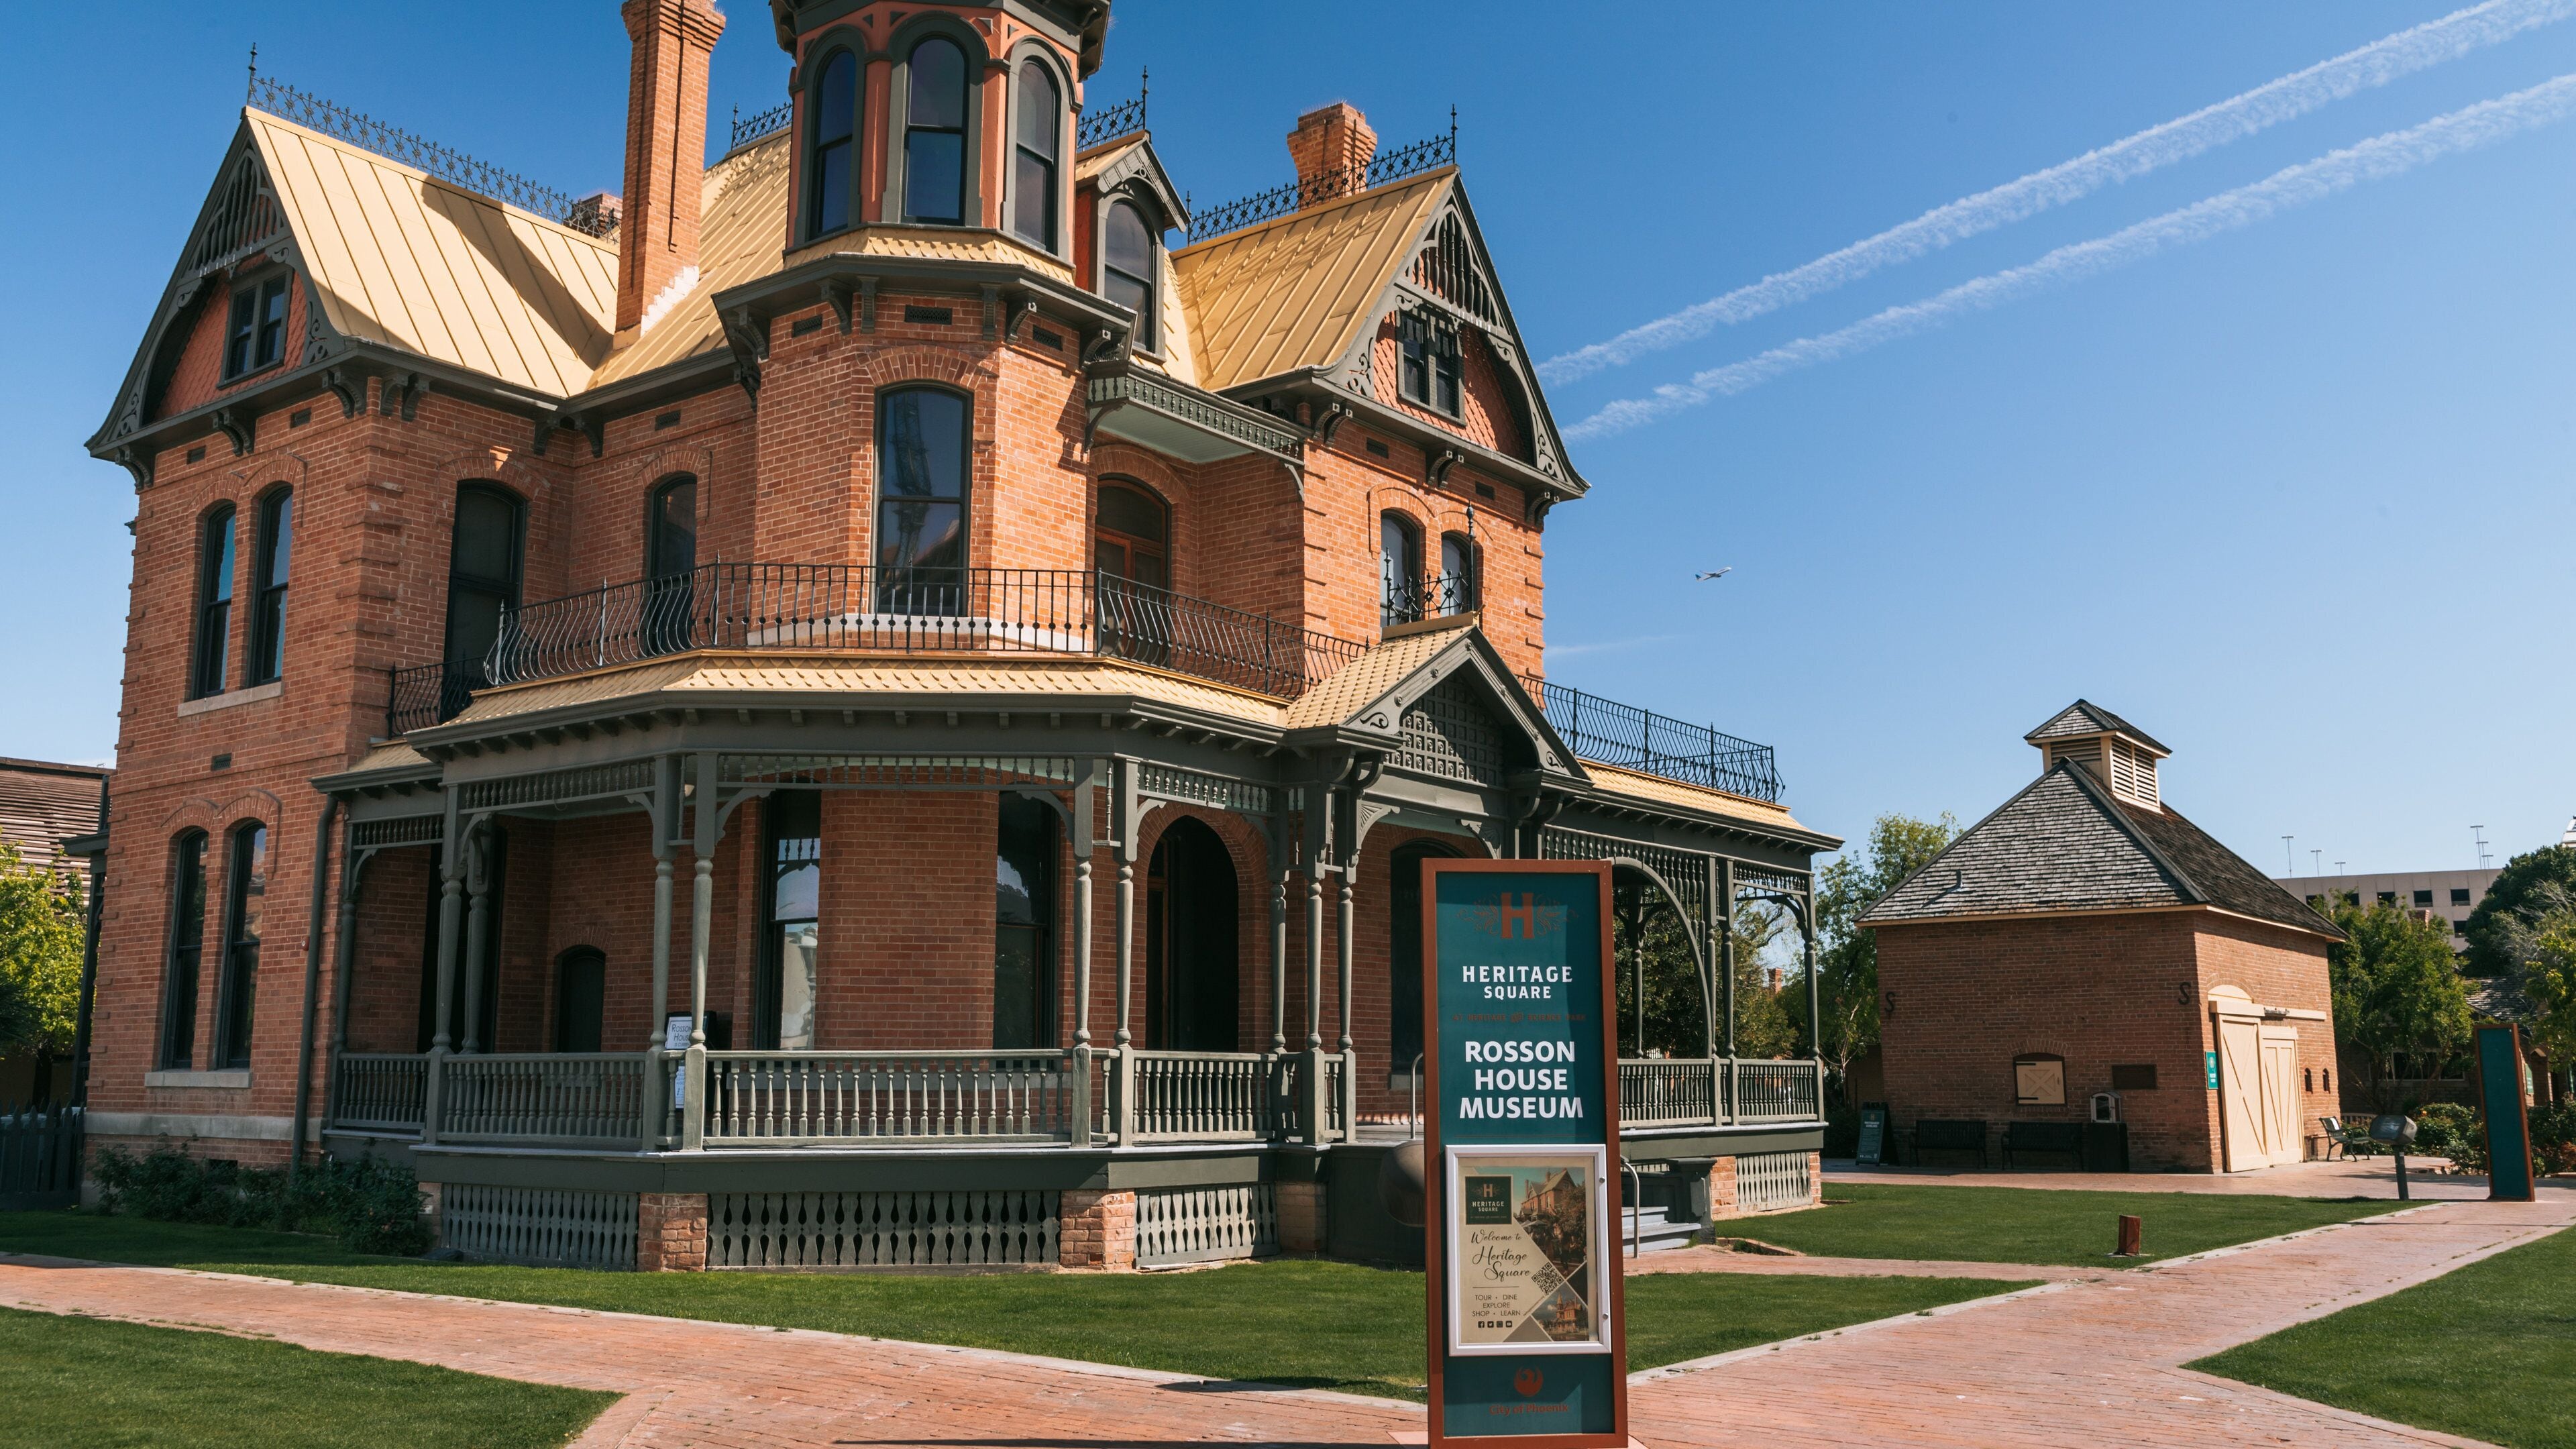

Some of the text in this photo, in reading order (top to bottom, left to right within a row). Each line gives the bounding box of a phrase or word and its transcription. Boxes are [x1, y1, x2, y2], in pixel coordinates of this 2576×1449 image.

[1500, 892, 1534, 939] H
[1462, 965, 1573, 983] HERITAGE
[1483, 985, 1552, 1000] SQUARE
[674, 1032, 688, 1041] HOUS
[1464, 1040, 1576, 1063] ROSSON
[1474, 1069, 1568, 1091] HOUSE
[1459, 1097, 1584, 1119] MUSEUM
[1483, 1183, 1493, 1197] H
[1471, 1229, 1513, 1244] Welcome
[1472, 1245, 1528, 1266] Heritage
[1484, 1260, 1531, 1282] Square
[1489, 1403, 1568, 1416] City of Phoenix
